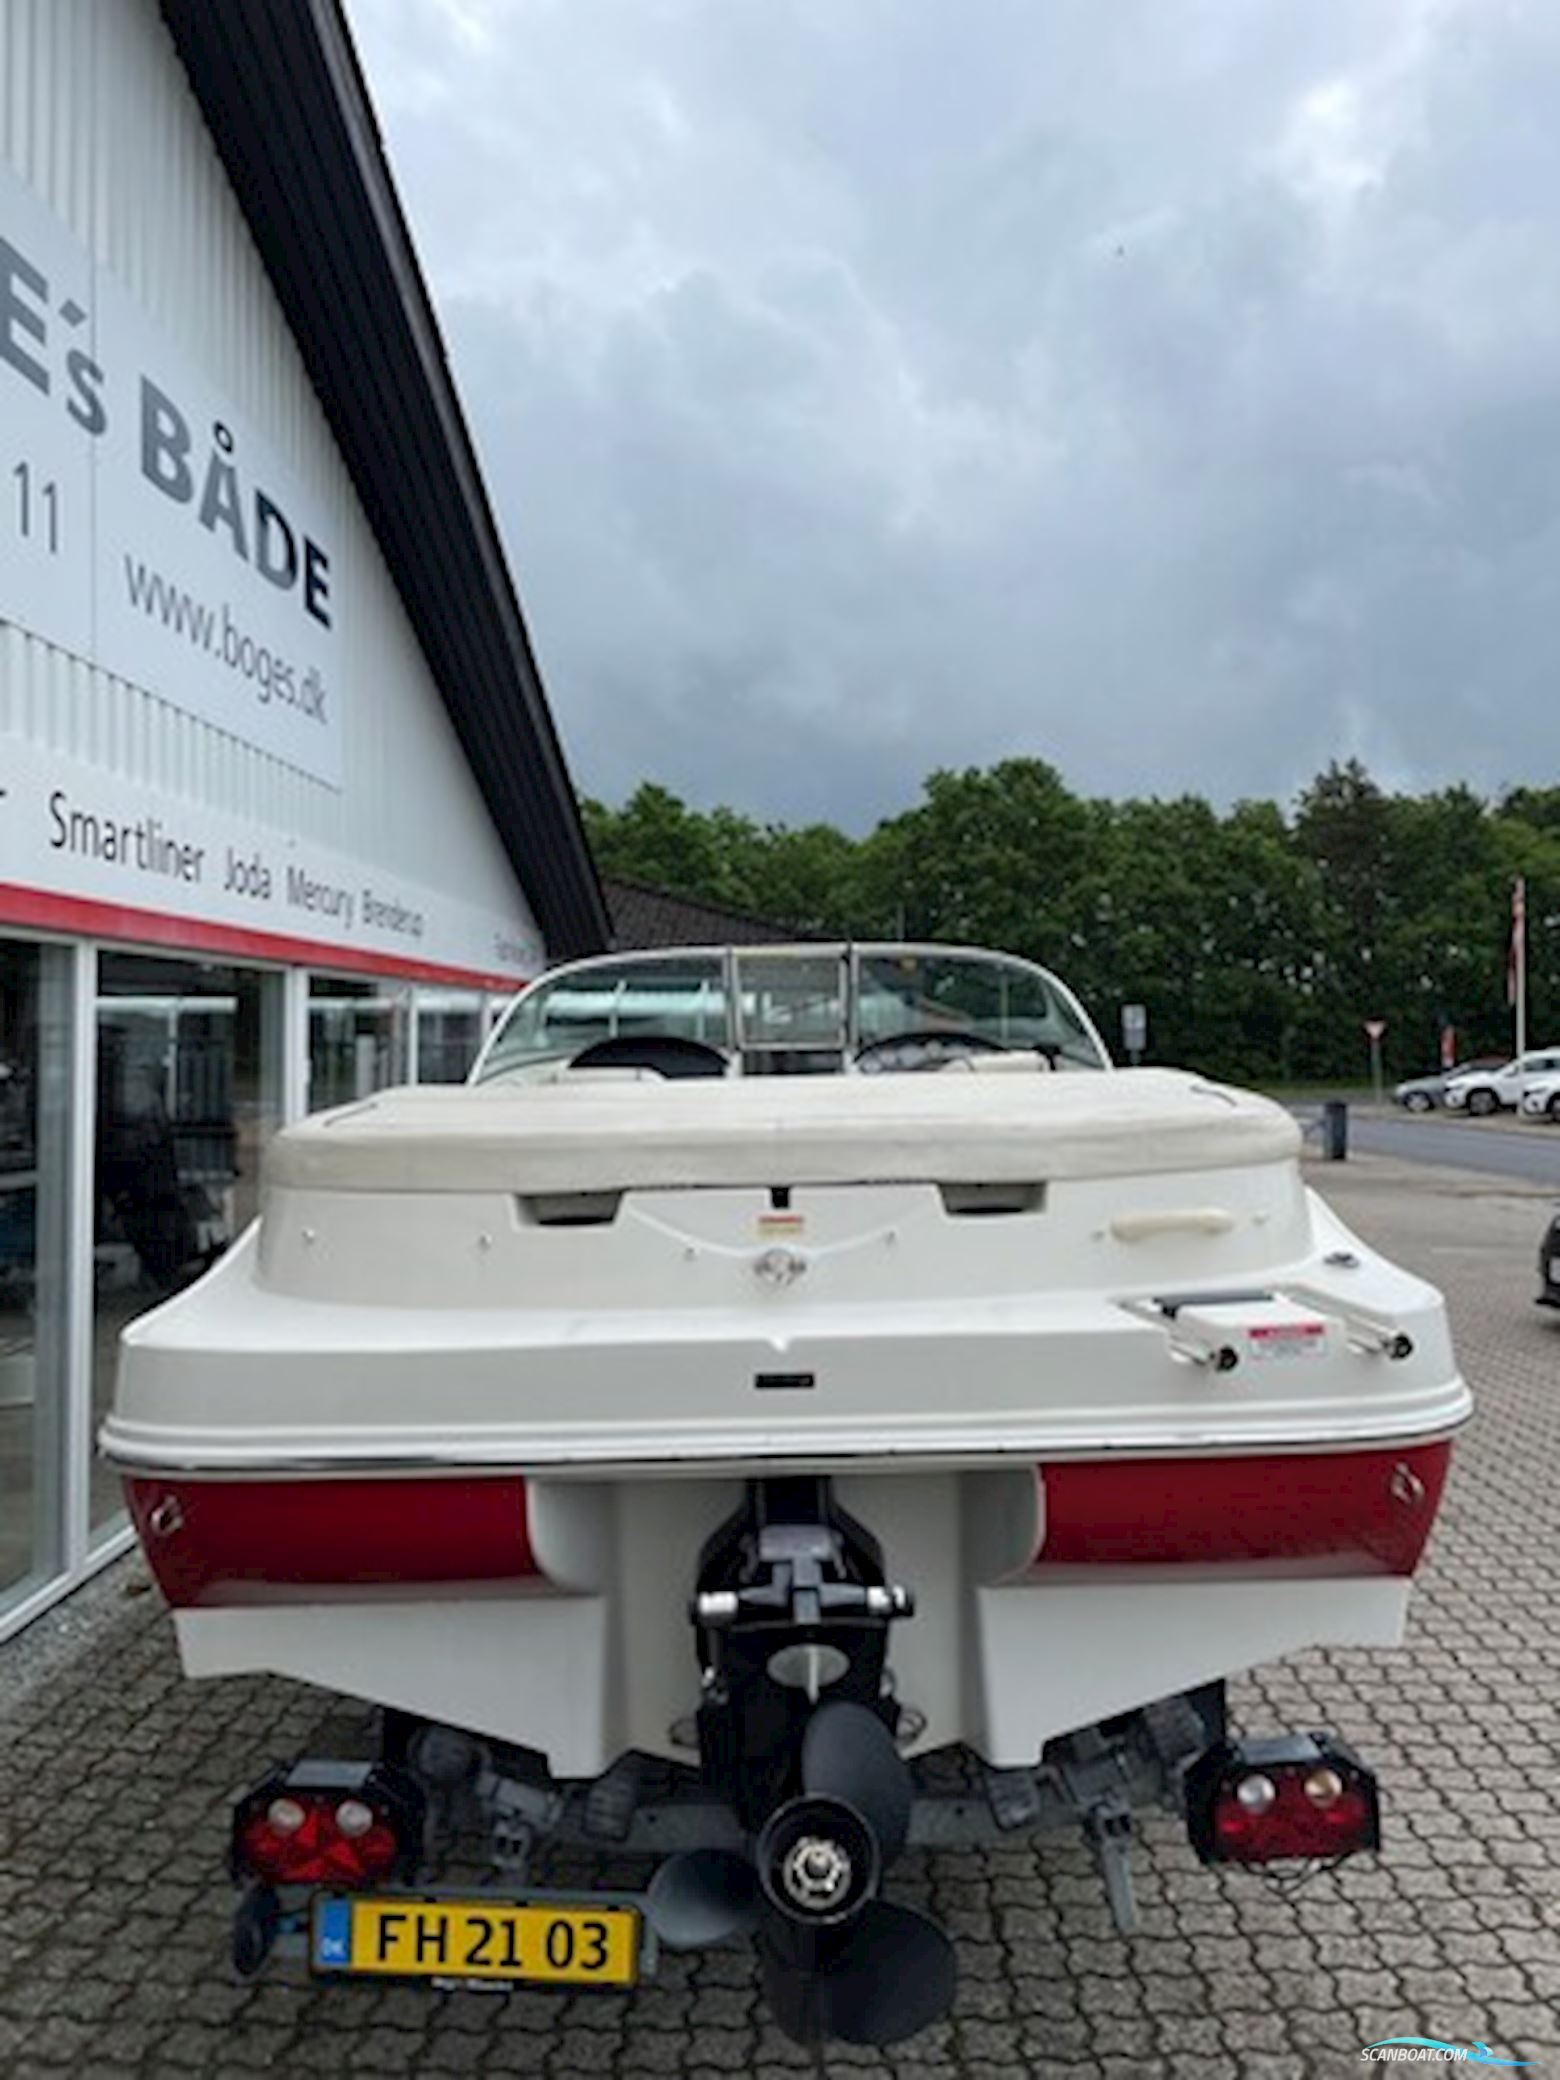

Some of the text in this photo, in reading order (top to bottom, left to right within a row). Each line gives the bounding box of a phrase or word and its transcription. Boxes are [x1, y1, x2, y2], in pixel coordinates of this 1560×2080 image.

[13, 461, 58, 554] 11
[140, 373, 332, 630] BÅDE
[124, 553, 328, 725] www.boges.dk
[49, 790, 205, 883] Smartliner
[223, 848, 271, 900] Joda
[286, 865, 354, 930] Mercury
[377, 1914, 447, 1963] FH
[464, 1917, 523, 1967] 21
[545, 1920, 609, 1970] 03
